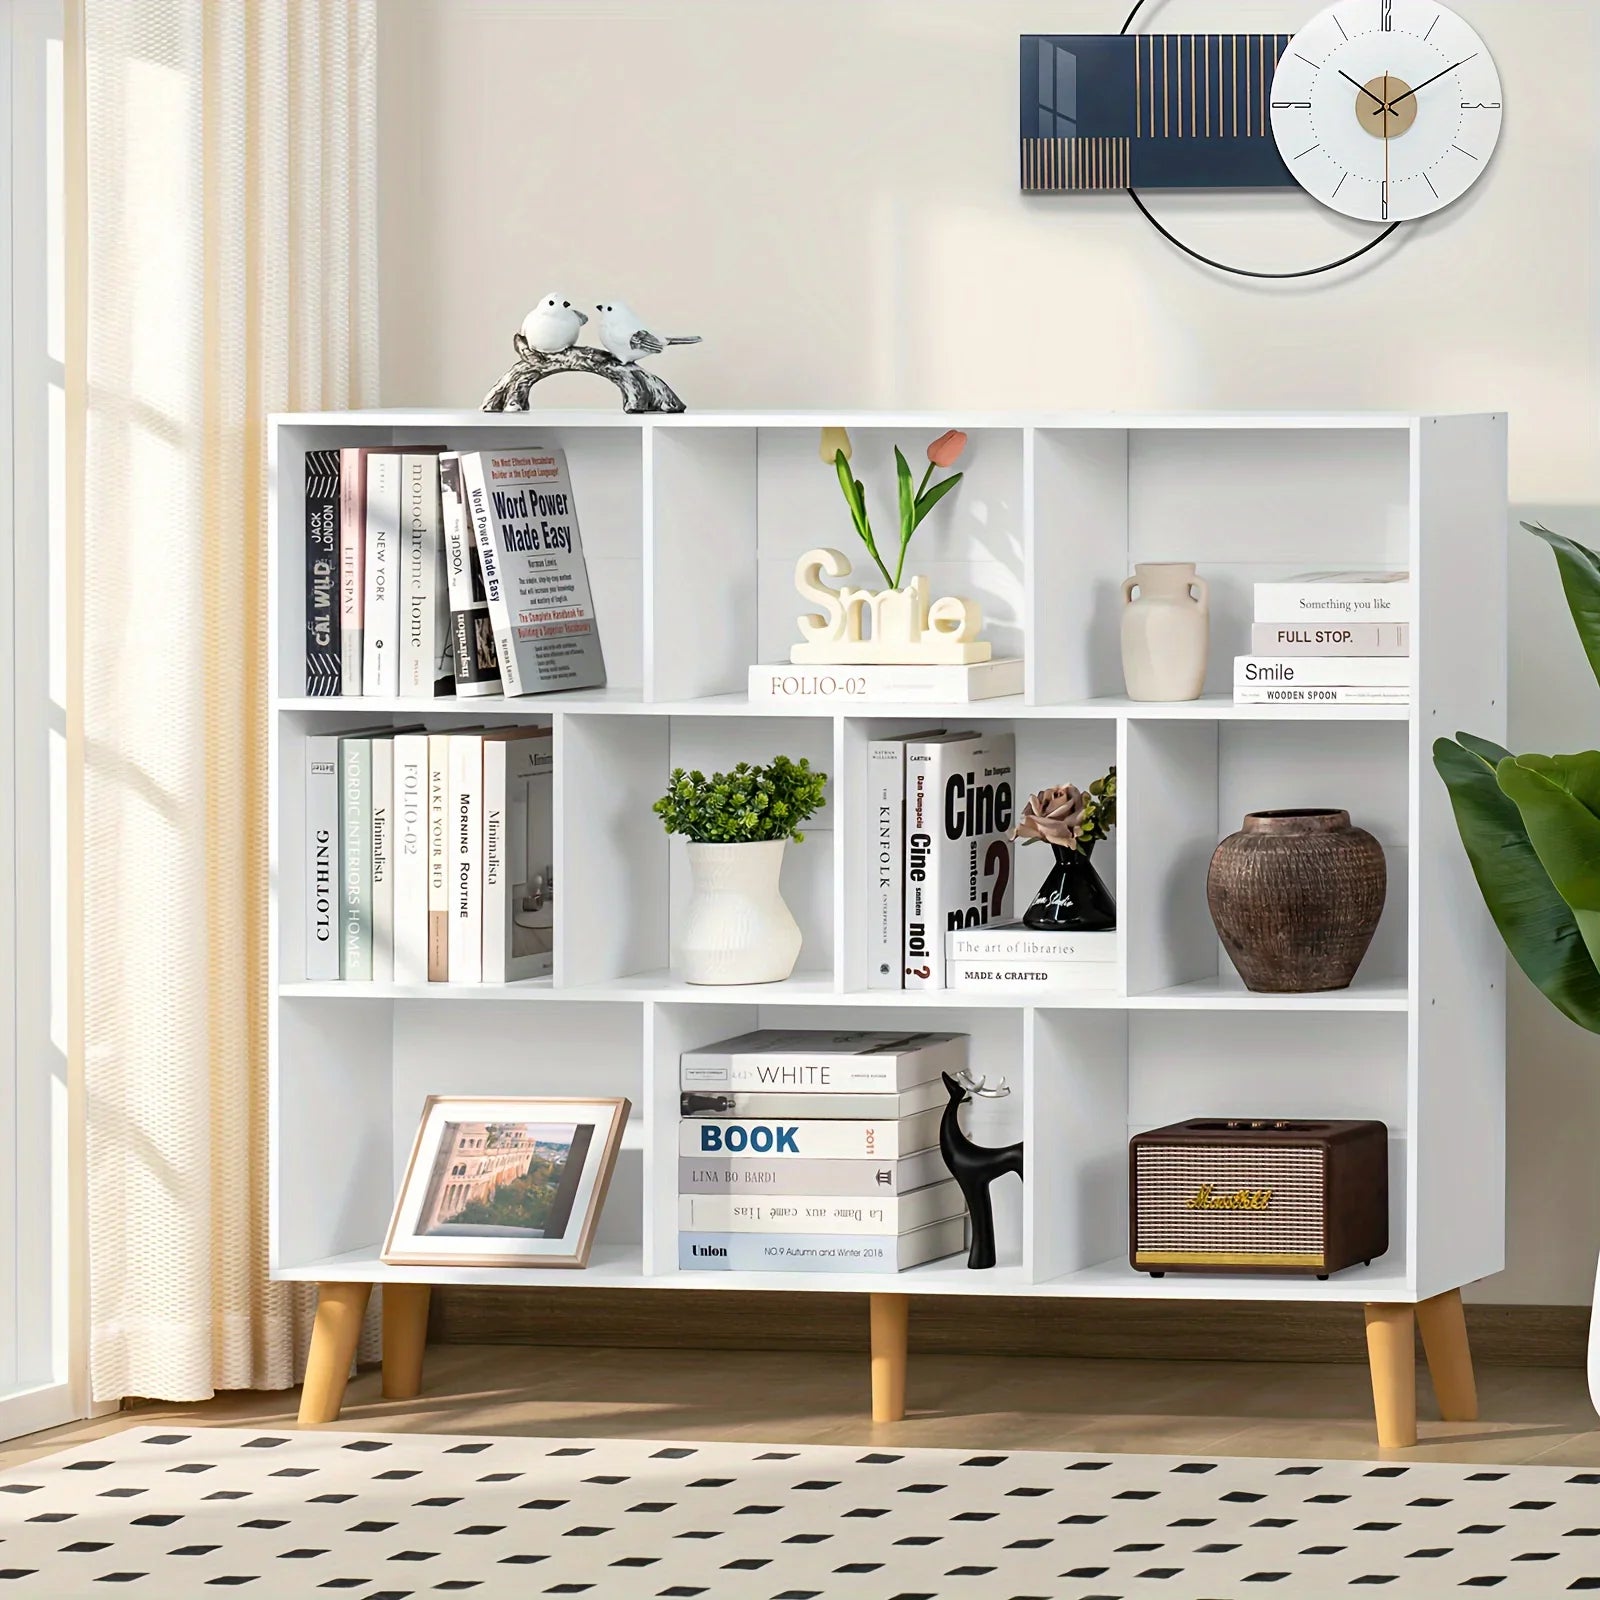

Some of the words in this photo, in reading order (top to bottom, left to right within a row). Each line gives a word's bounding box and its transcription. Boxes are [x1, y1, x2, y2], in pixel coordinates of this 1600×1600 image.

[472, 488, 485, 514] Word
[492, 491, 528, 520] Word
[529, 489, 569, 517] Power
[311, 513, 321, 543] JACK
[323, 505, 333, 551] LONDON
[412, 464, 427, 589] monochrome
[477, 517, 490, 546] Power
[502, 523, 540, 552] Made
[541, 521, 571, 554] Easy
[377, 531, 386, 562] NEW
[451, 534, 463, 575] VOGUE
[484, 549, 496, 577] Made
[376, 568, 386, 601] YORK
[489, 578, 501, 602] Easy
[412, 596, 427, 647] home
[1299, 598, 1351, 612] Something
[1353, 602, 1371, 612] you
[1374, 599, 1391, 609] like
[456, 613, 471, 677] inspiration
[1277, 631, 1312, 643] FULL
[1315, 631, 1353, 643] STOP.
[771, 676, 867, 695] FOLIO-02
[1245, 663, 1294, 681] Smile
[1267, 691, 1304, 700] WOODEN
[1307, 691, 1337, 700] SPOON
[348, 752, 360, 817] NORDIC
[404, 764, 417, 855] FOLIO-02
[945, 771, 1012, 840] Cine
[433, 818, 442, 857] YOUR
[460, 793, 470, 854] MORNING
[348, 821, 360, 905] INTERIORS
[880, 807, 891, 888] KINFOLK
[910, 834, 931, 882] Cine
[317, 830, 330, 942] CLOTHING
[460, 862, 470, 918] ROUTINE
[947, 892, 988, 931] noi
[348, 909, 360, 968] HOMES
[909, 923, 930, 957] noi
[958, 942, 979, 953] The
[985, 944, 1001, 953] art
[1007, 942, 1020, 953] of
[1024, 942, 1075, 954] libraries
[965, 972, 993, 980] MADE
[996, 972, 1002, 980] &
[1005, 972, 1048, 980] CRAFTED
[757, 1066, 831, 1085] WHITE
[701, 1125, 800, 1153] BOOK
[866, 1129, 875, 1155] 2011
[692, 1170, 719, 1182] LINA
[725, 1171, 739, 1182] BO
[745, 1171, 777, 1183] BARDI
[786, 1247, 817, 1256] Autumn
[819, 1248, 835, 1256] and
[837, 1247, 861, 1257] Winter
[864, 1248, 883, 1257] 2018
